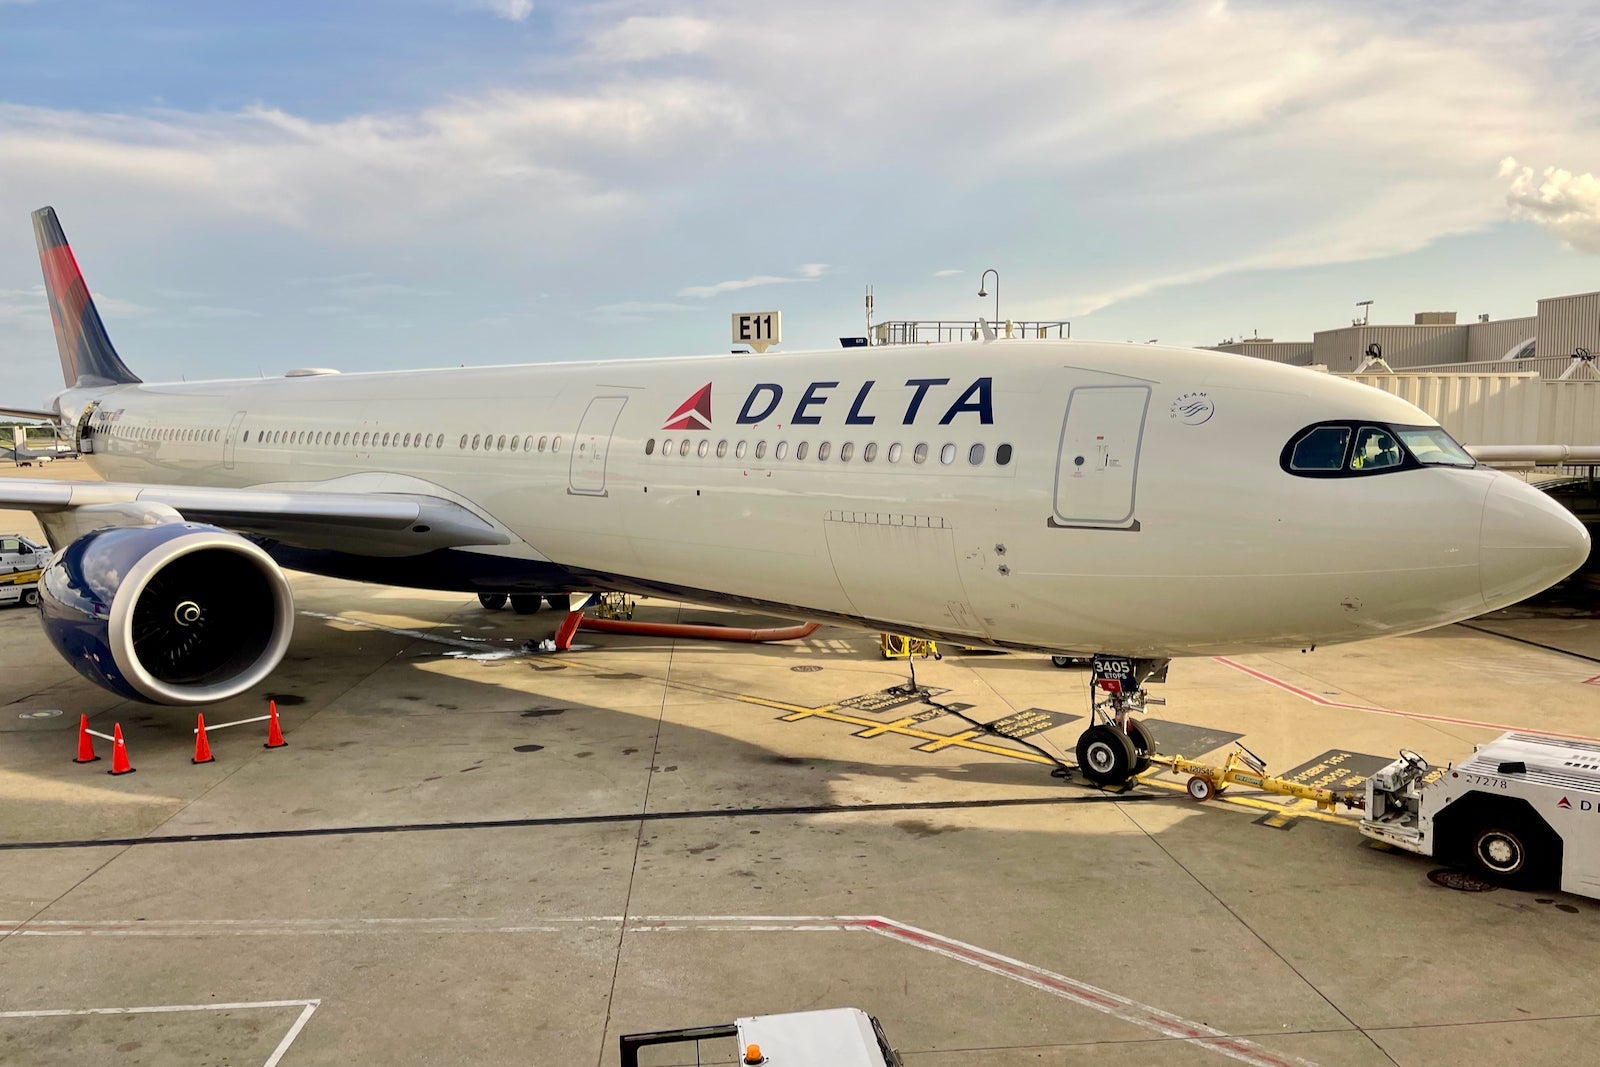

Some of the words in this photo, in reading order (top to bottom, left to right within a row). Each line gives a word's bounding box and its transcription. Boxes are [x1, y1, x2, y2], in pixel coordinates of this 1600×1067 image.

[740, 315, 772, 340] E11
[736, 377, 994, 425] DELTA
[1170, 392, 1207, 418] SKYTEAM
[1095, 661, 1130, 673] 3405
